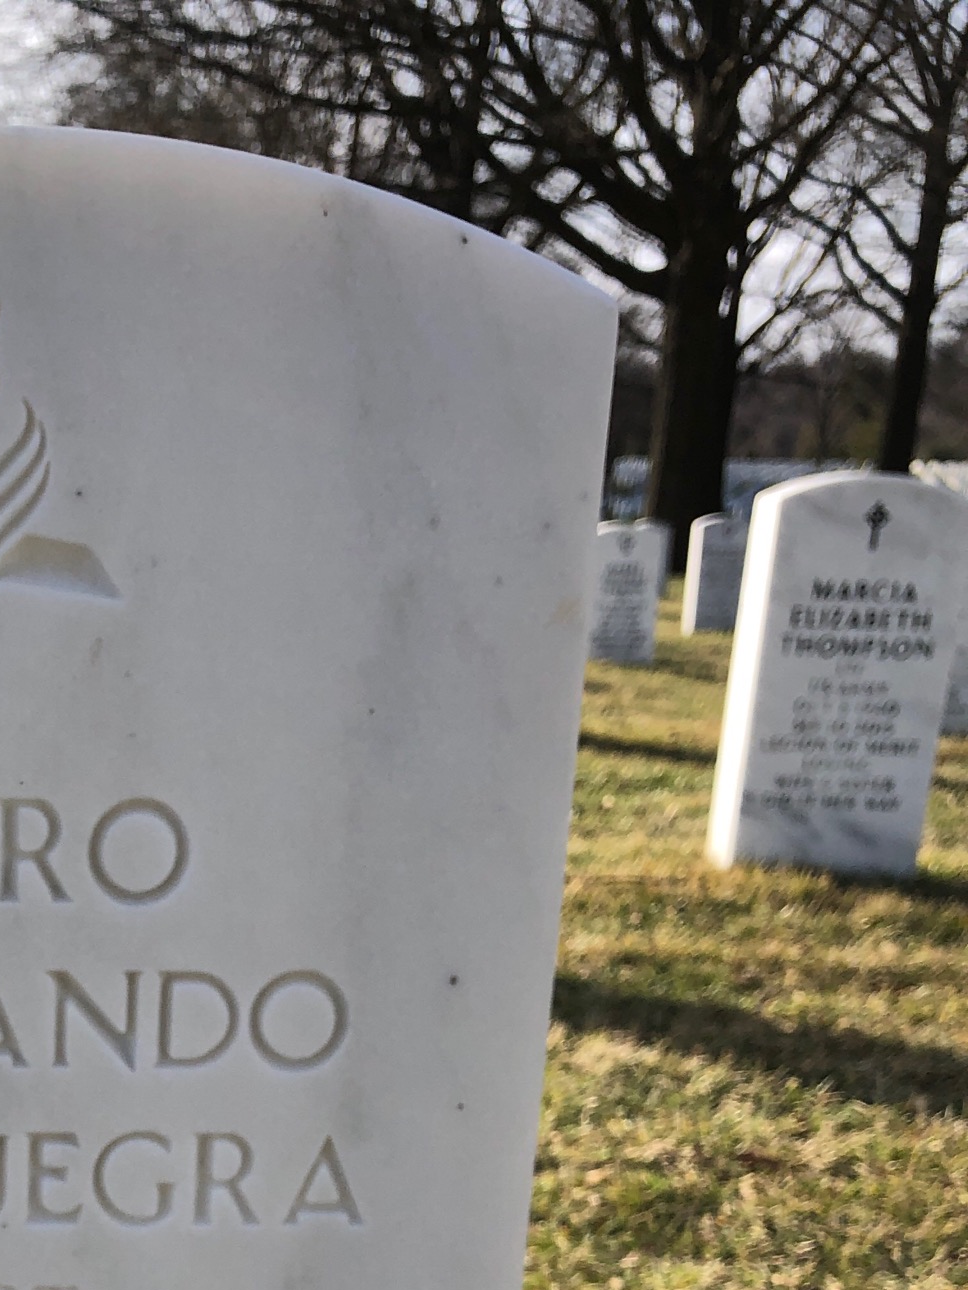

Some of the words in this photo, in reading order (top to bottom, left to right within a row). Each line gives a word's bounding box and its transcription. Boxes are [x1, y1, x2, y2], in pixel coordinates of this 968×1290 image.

[811, 576, 918, 602] MARCIA
[788, 603, 934, 632] ELIZABETH
[781, 632, 934, 662] THOMPSON
